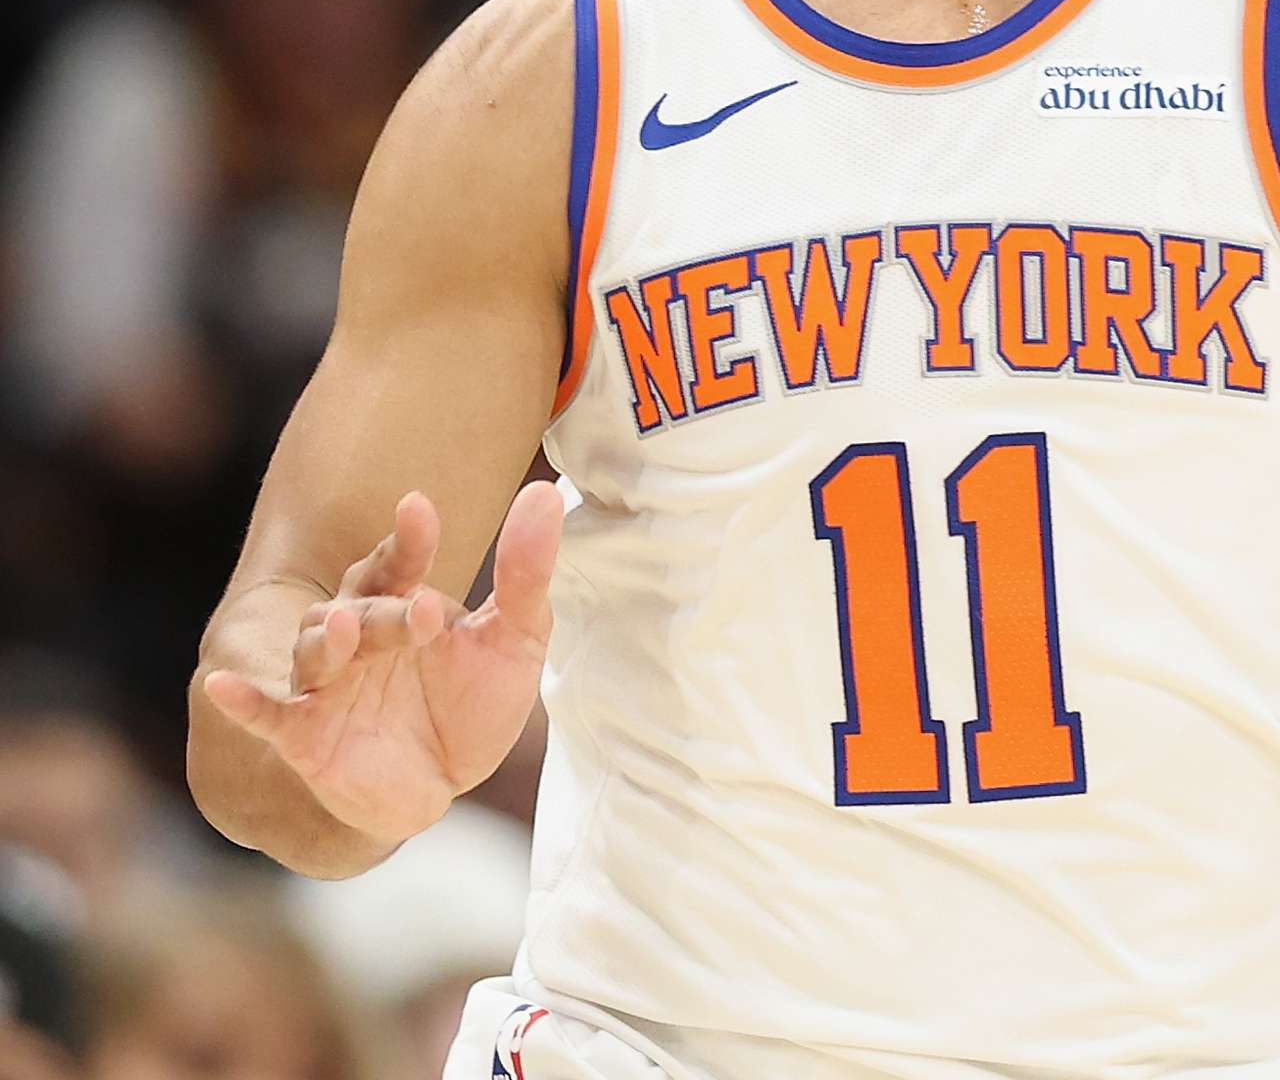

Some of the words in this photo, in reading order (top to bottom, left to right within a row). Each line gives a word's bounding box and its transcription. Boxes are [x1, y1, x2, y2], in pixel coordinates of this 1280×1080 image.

[1040, 81, 1110, 110] abu
[1120, 81, 1226, 112] dhabi
[1044, 64, 1142, 79] experience
[602, 230, 884, 438] NEW
[895, 222, 1269, 396] YORK
[809, 432, 1087, 807] 11
